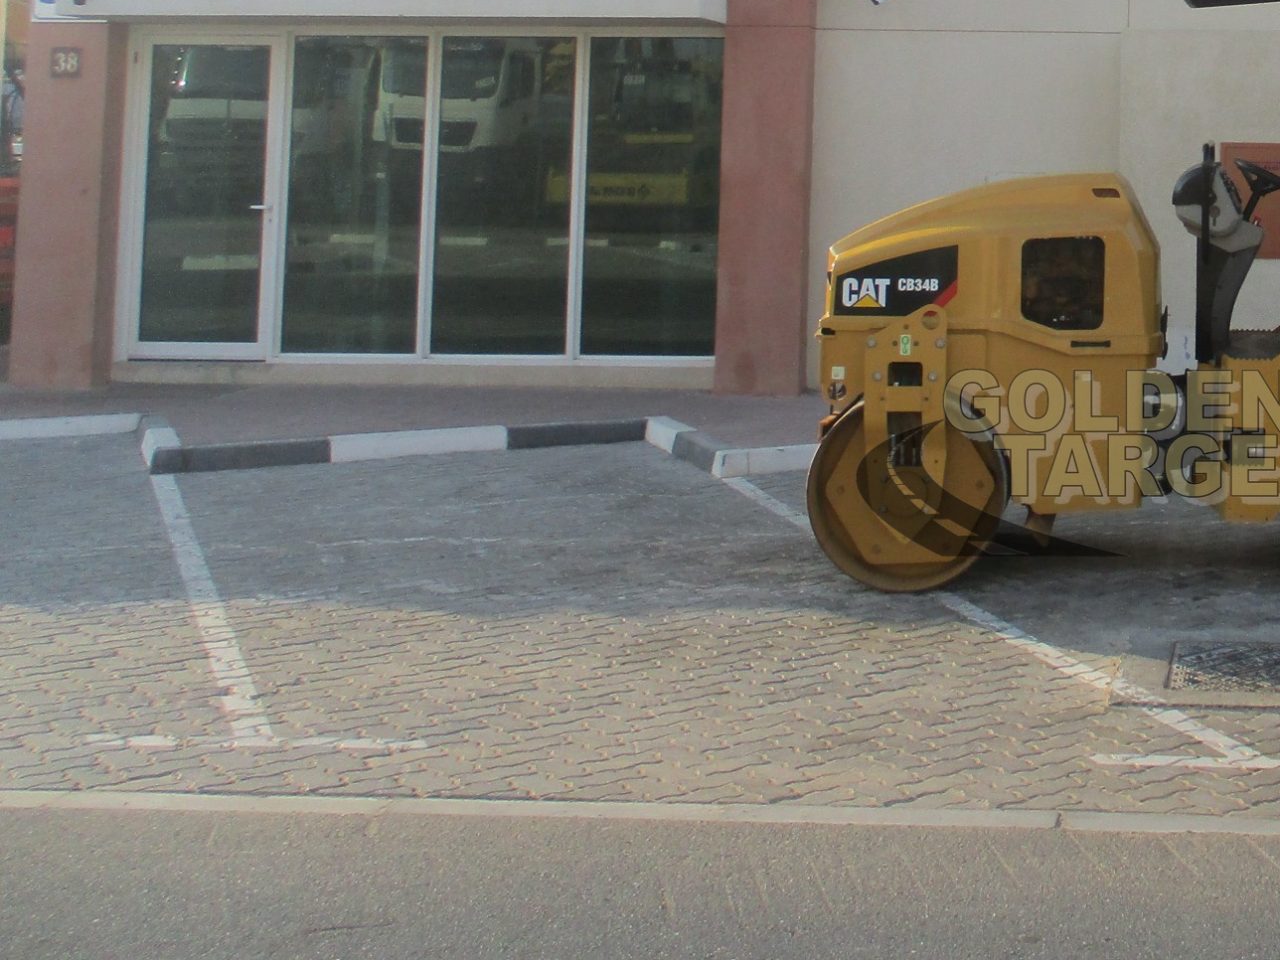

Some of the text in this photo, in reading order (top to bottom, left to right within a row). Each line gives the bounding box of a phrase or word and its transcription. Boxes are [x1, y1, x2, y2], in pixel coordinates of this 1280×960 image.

[53, 51, 79, 73] 38
[842, 277, 939, 308] CAT CB34B
